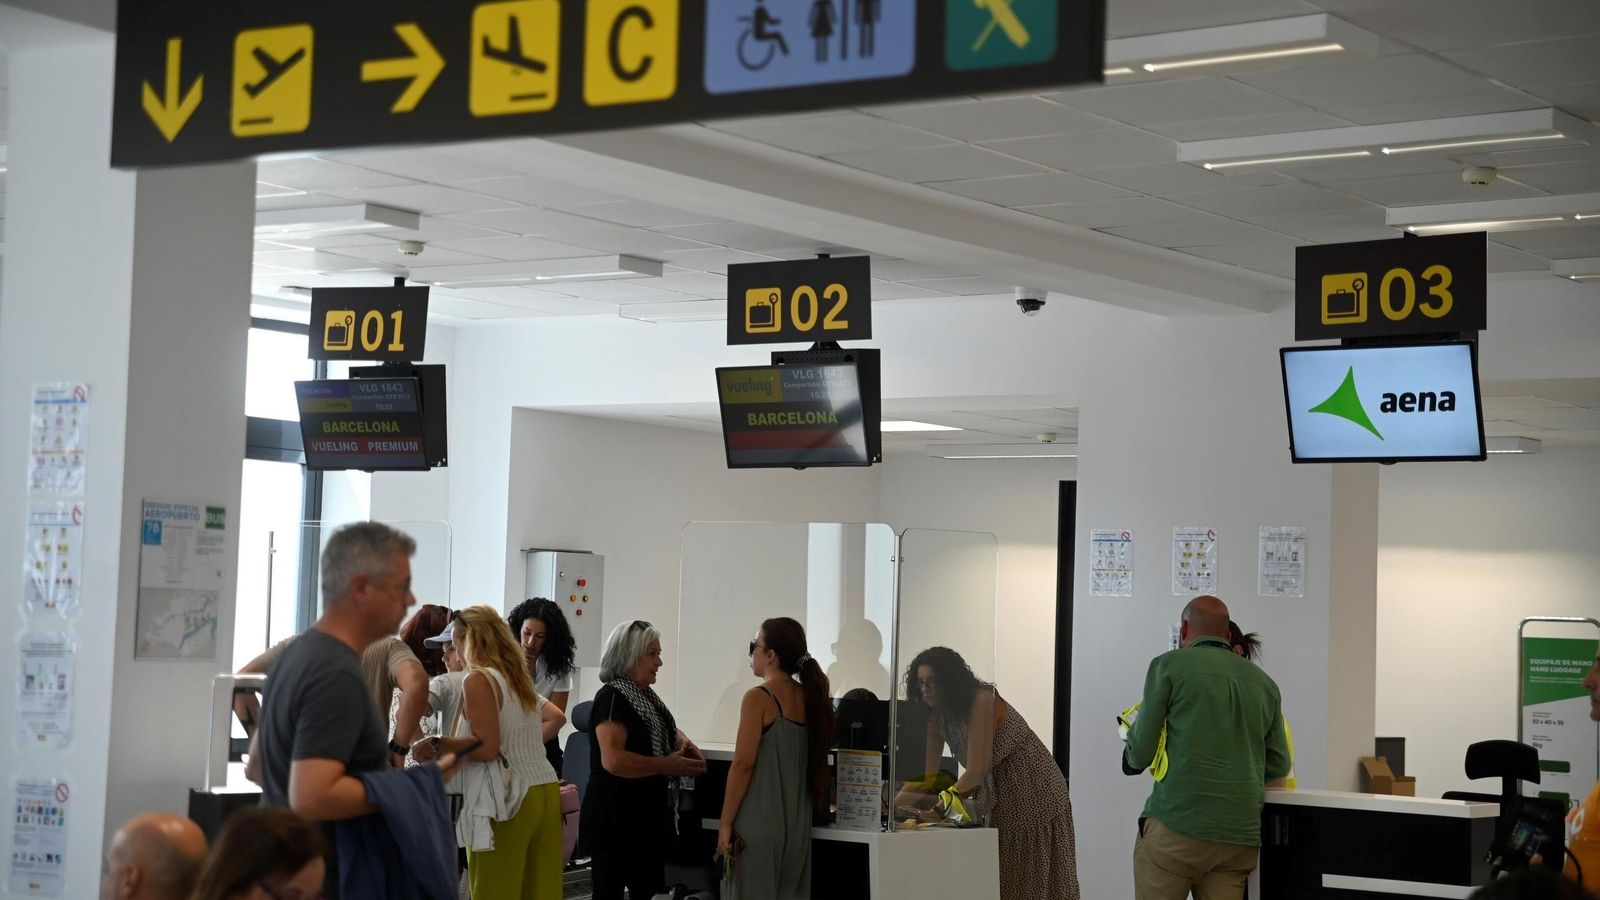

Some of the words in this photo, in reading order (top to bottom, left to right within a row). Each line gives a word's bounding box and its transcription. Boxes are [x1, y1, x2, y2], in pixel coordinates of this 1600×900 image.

[608, 5, 655, 83] C
[1379, 264, 1454, 321] 03
[790, 283, 849, 332] 02
[360, 309, 405, 352] 01
[791, 370, 814, 381] VLG
[359, 383, 378, 393] VLG
[381, 382, 404, 393] 1643
[727, 377, 773, 396] vueling
[1380, 390, 1456, 413] aena
[747, 411, 839, 426] BARCELONA
[322, 421, 400, 433] BARCELONA
[311, 441, 359, 452] VUELING
[367, 441, 418, 452] PREMIUM
[145, 510, 201, 521] AEROPUERTO
[206, 513, 226, 523] BUS
[1530, 658, 1561, 666] EQUIPAJE
